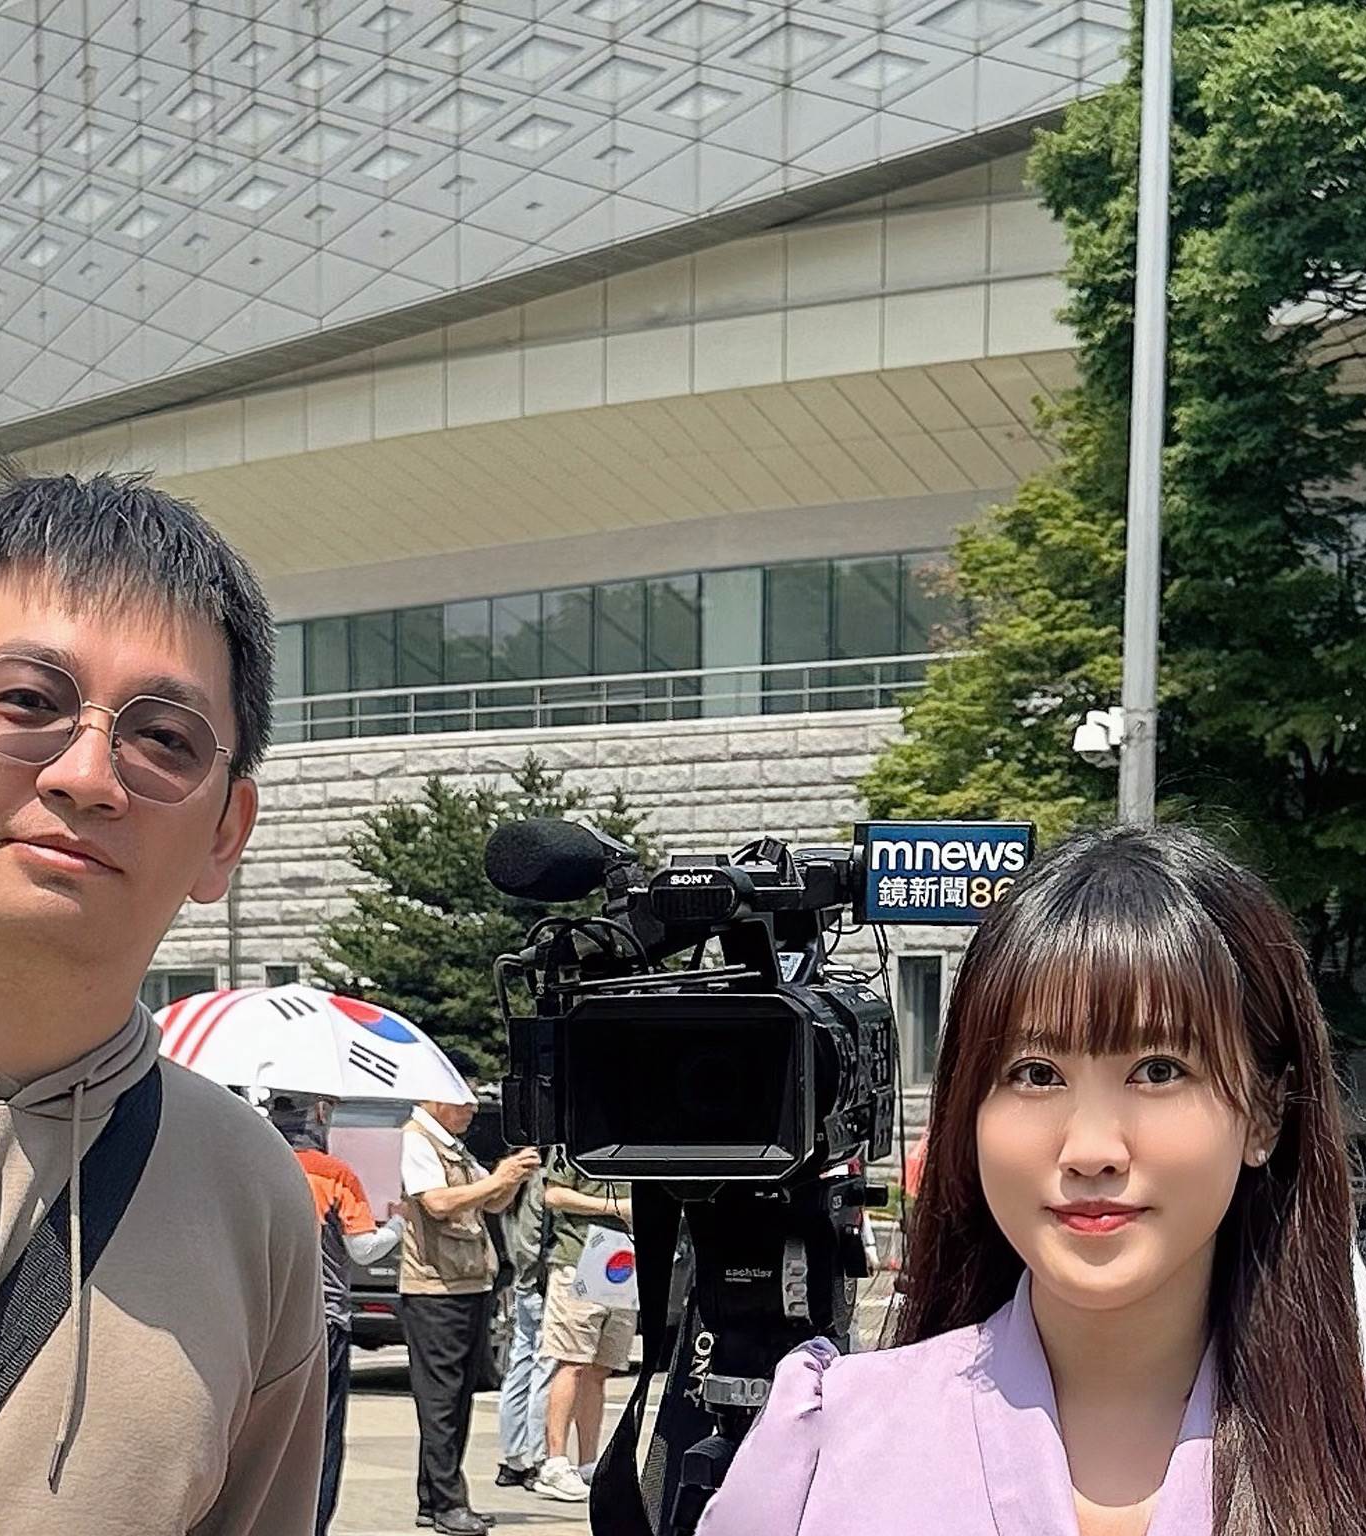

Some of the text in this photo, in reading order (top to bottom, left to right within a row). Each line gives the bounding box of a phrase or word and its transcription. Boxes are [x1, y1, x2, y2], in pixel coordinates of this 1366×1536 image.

[871, 840, 1026, 872] mnews
[670, 874, 713, 886] SONY
[683, 1331, 715, 1408] ONY
